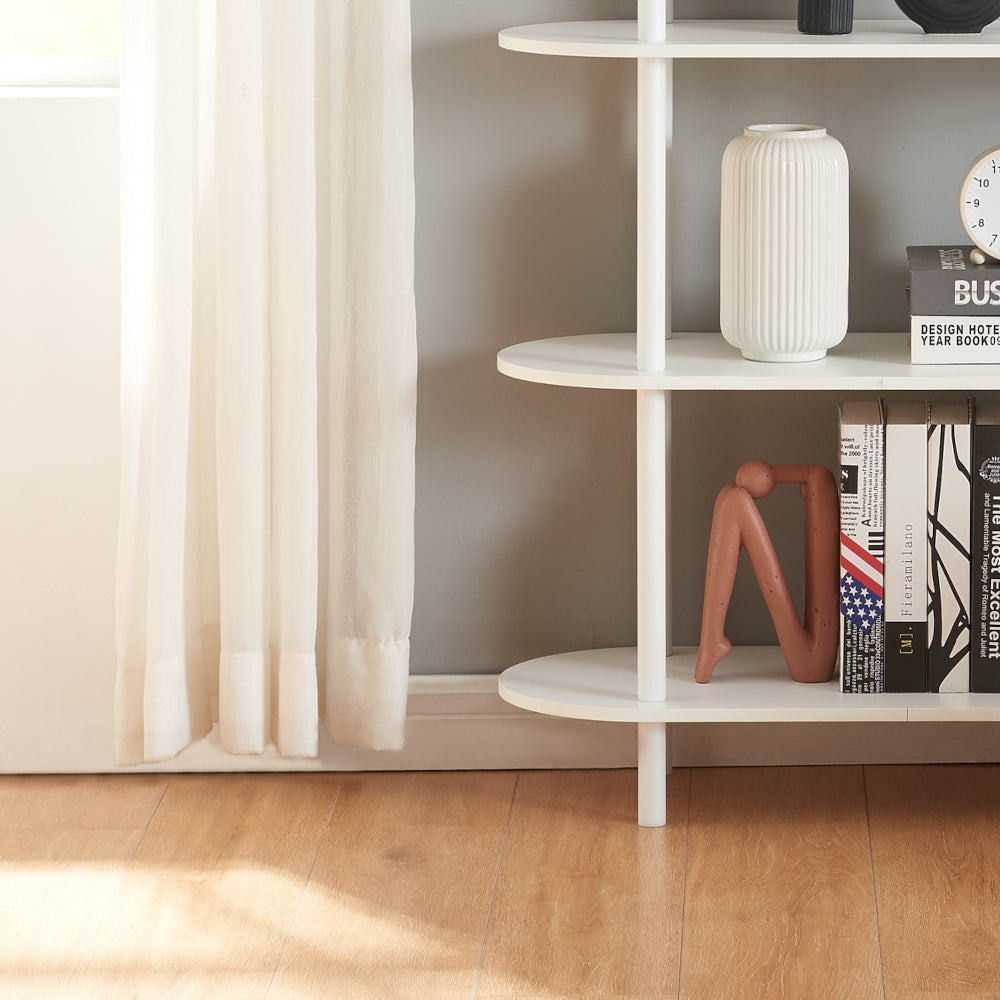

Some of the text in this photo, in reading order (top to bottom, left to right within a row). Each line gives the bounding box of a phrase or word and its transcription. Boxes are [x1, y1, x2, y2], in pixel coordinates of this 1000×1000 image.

[978, 178, 990, 188] 10
[973, 198, 980, 208] 9
[978, 218, 985, 228] 8
[991, 234, 998, 243] 7
[921, 324, 964, 335] DESIGN
[921, 335, 951, 346] YEAR
[983, 508, 991, 552] Lamentable
[901, 523, 913, 617] Fieramilano
[981, 553, 990, 584] Tragedy
[981, 584, 989, 593] of
[981, 594, 989, 621] Romeo
[980, 622, 988, 637] and
[980, 637, 988, 658] Juliet
